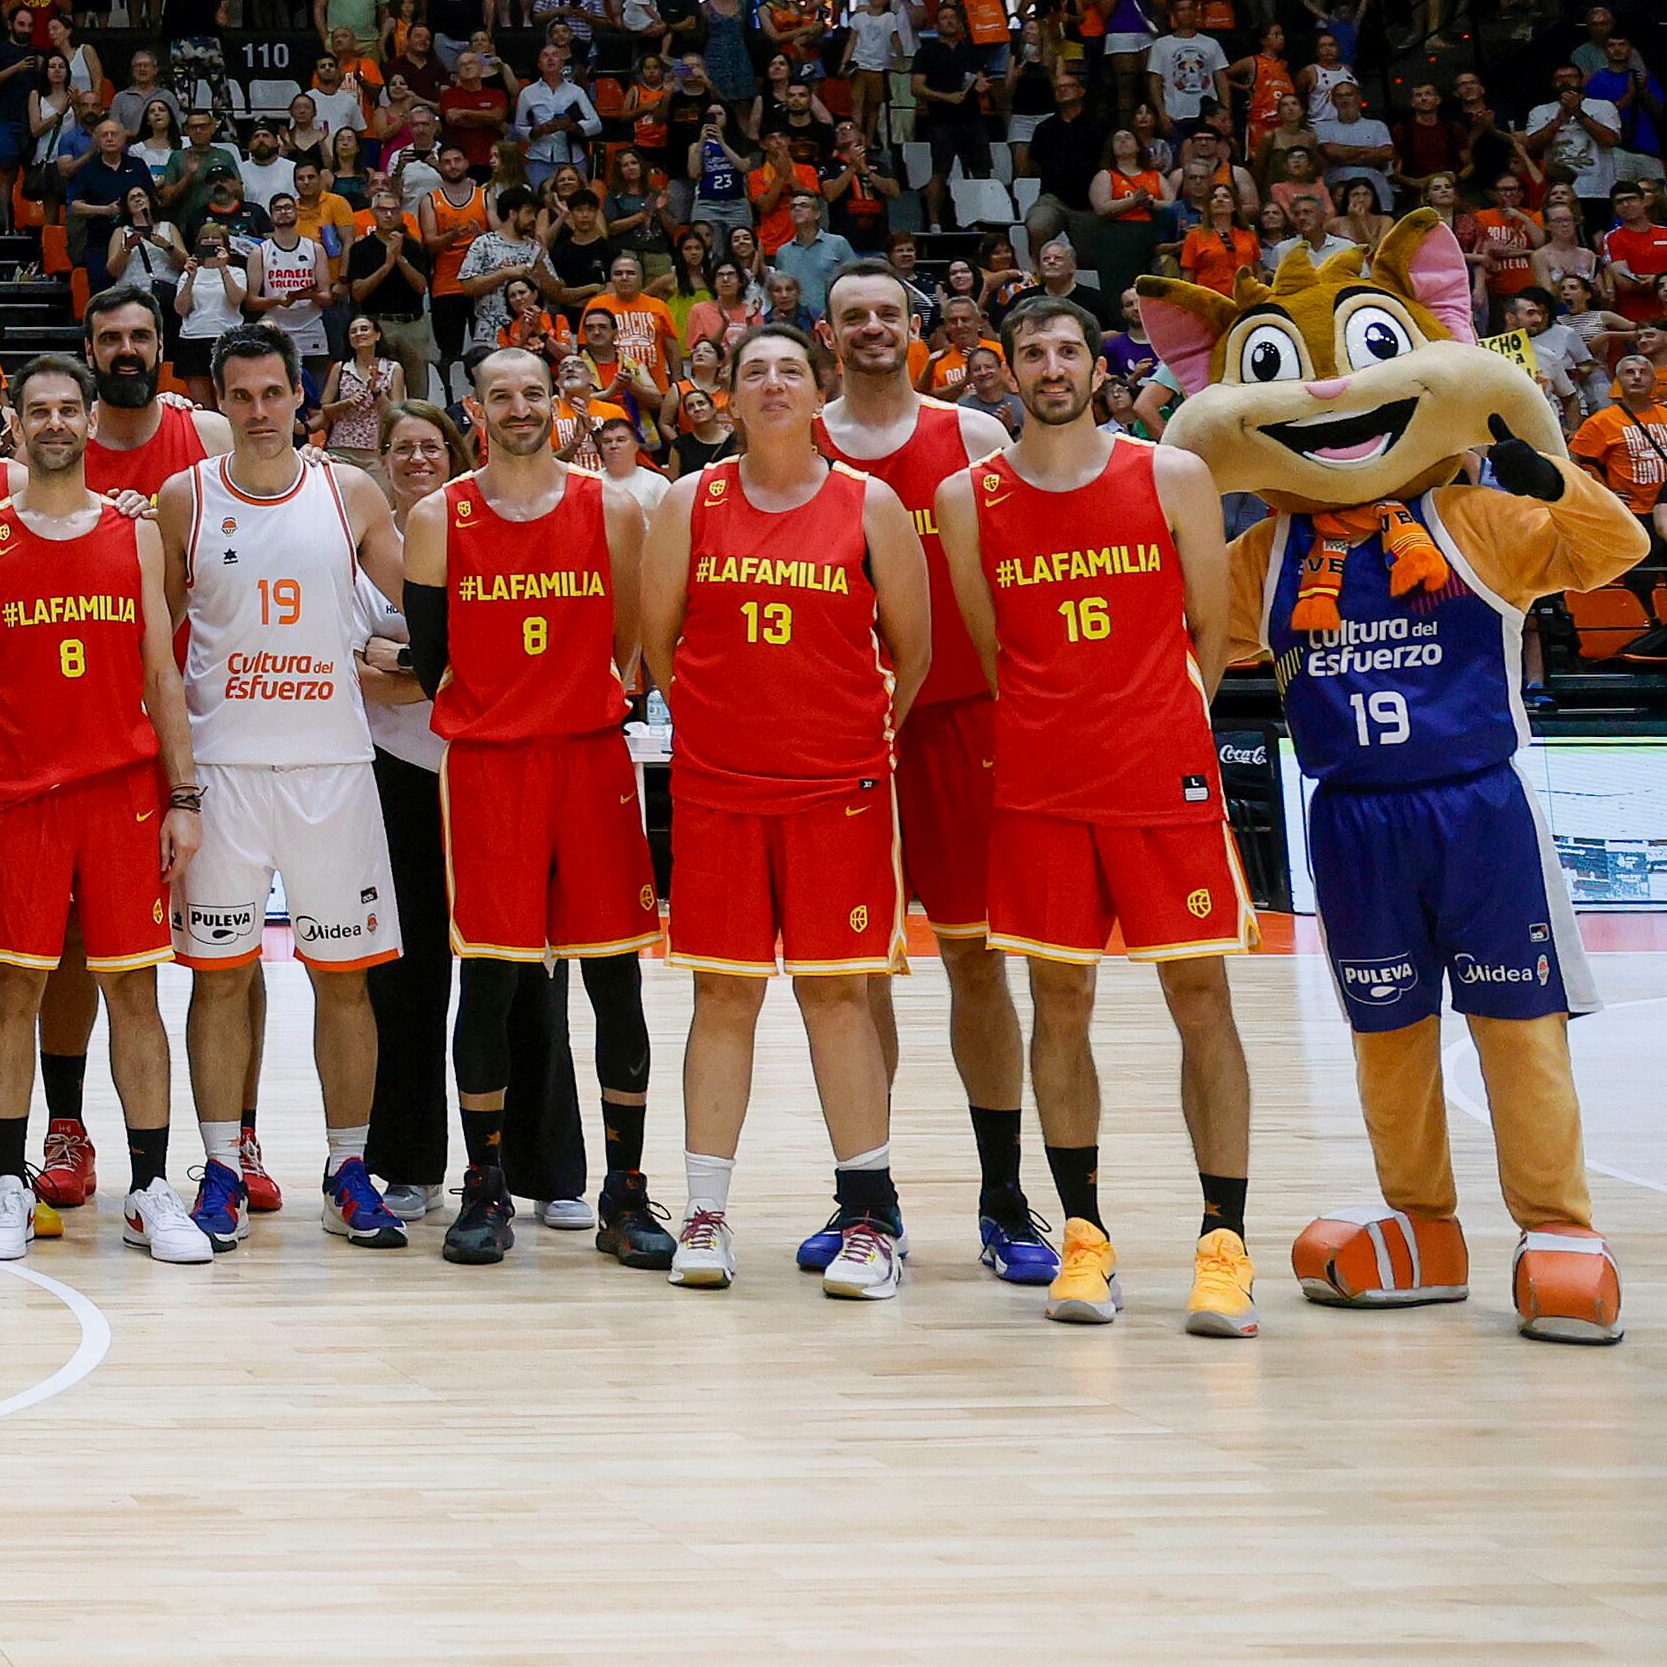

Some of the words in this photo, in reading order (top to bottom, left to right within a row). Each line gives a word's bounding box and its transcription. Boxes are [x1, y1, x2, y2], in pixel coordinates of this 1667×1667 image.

[242, 42, 291, 69] 110
[713, 174, 734, 190] 23
[695, 555, 849, 597] #LAFAMILIA
[995, 542, 1162, 589] #LAFAMILIA
[257, 577, 302, 626] 19
[458, 570, 606, 602] #LAFAMILIA
[1, 595, 136, 628] #LAFAMILIA
[739, 601, 793, 646] 13
[1057, 595, 1112, 643] 16
[522, 616, 548, 656] 8
[1411, 620, 1439, 638] del
[59, 638, 86, 679] 8
[227, 650, 312, 676] Cultura
[313, 660, 334, 675] del
[1307, 641, 1444, 678] Esfuerzo
[224, 675, 335, 702] Esfuerzo
[1349, 690, 1411, 747] 19
[190, 910, 252, 928] PULEVA
[307, 921, 363, 941] Midea
[1344, 960, 1414, 986] PULEVA
[1464, 956, 1534, 984] Midea
